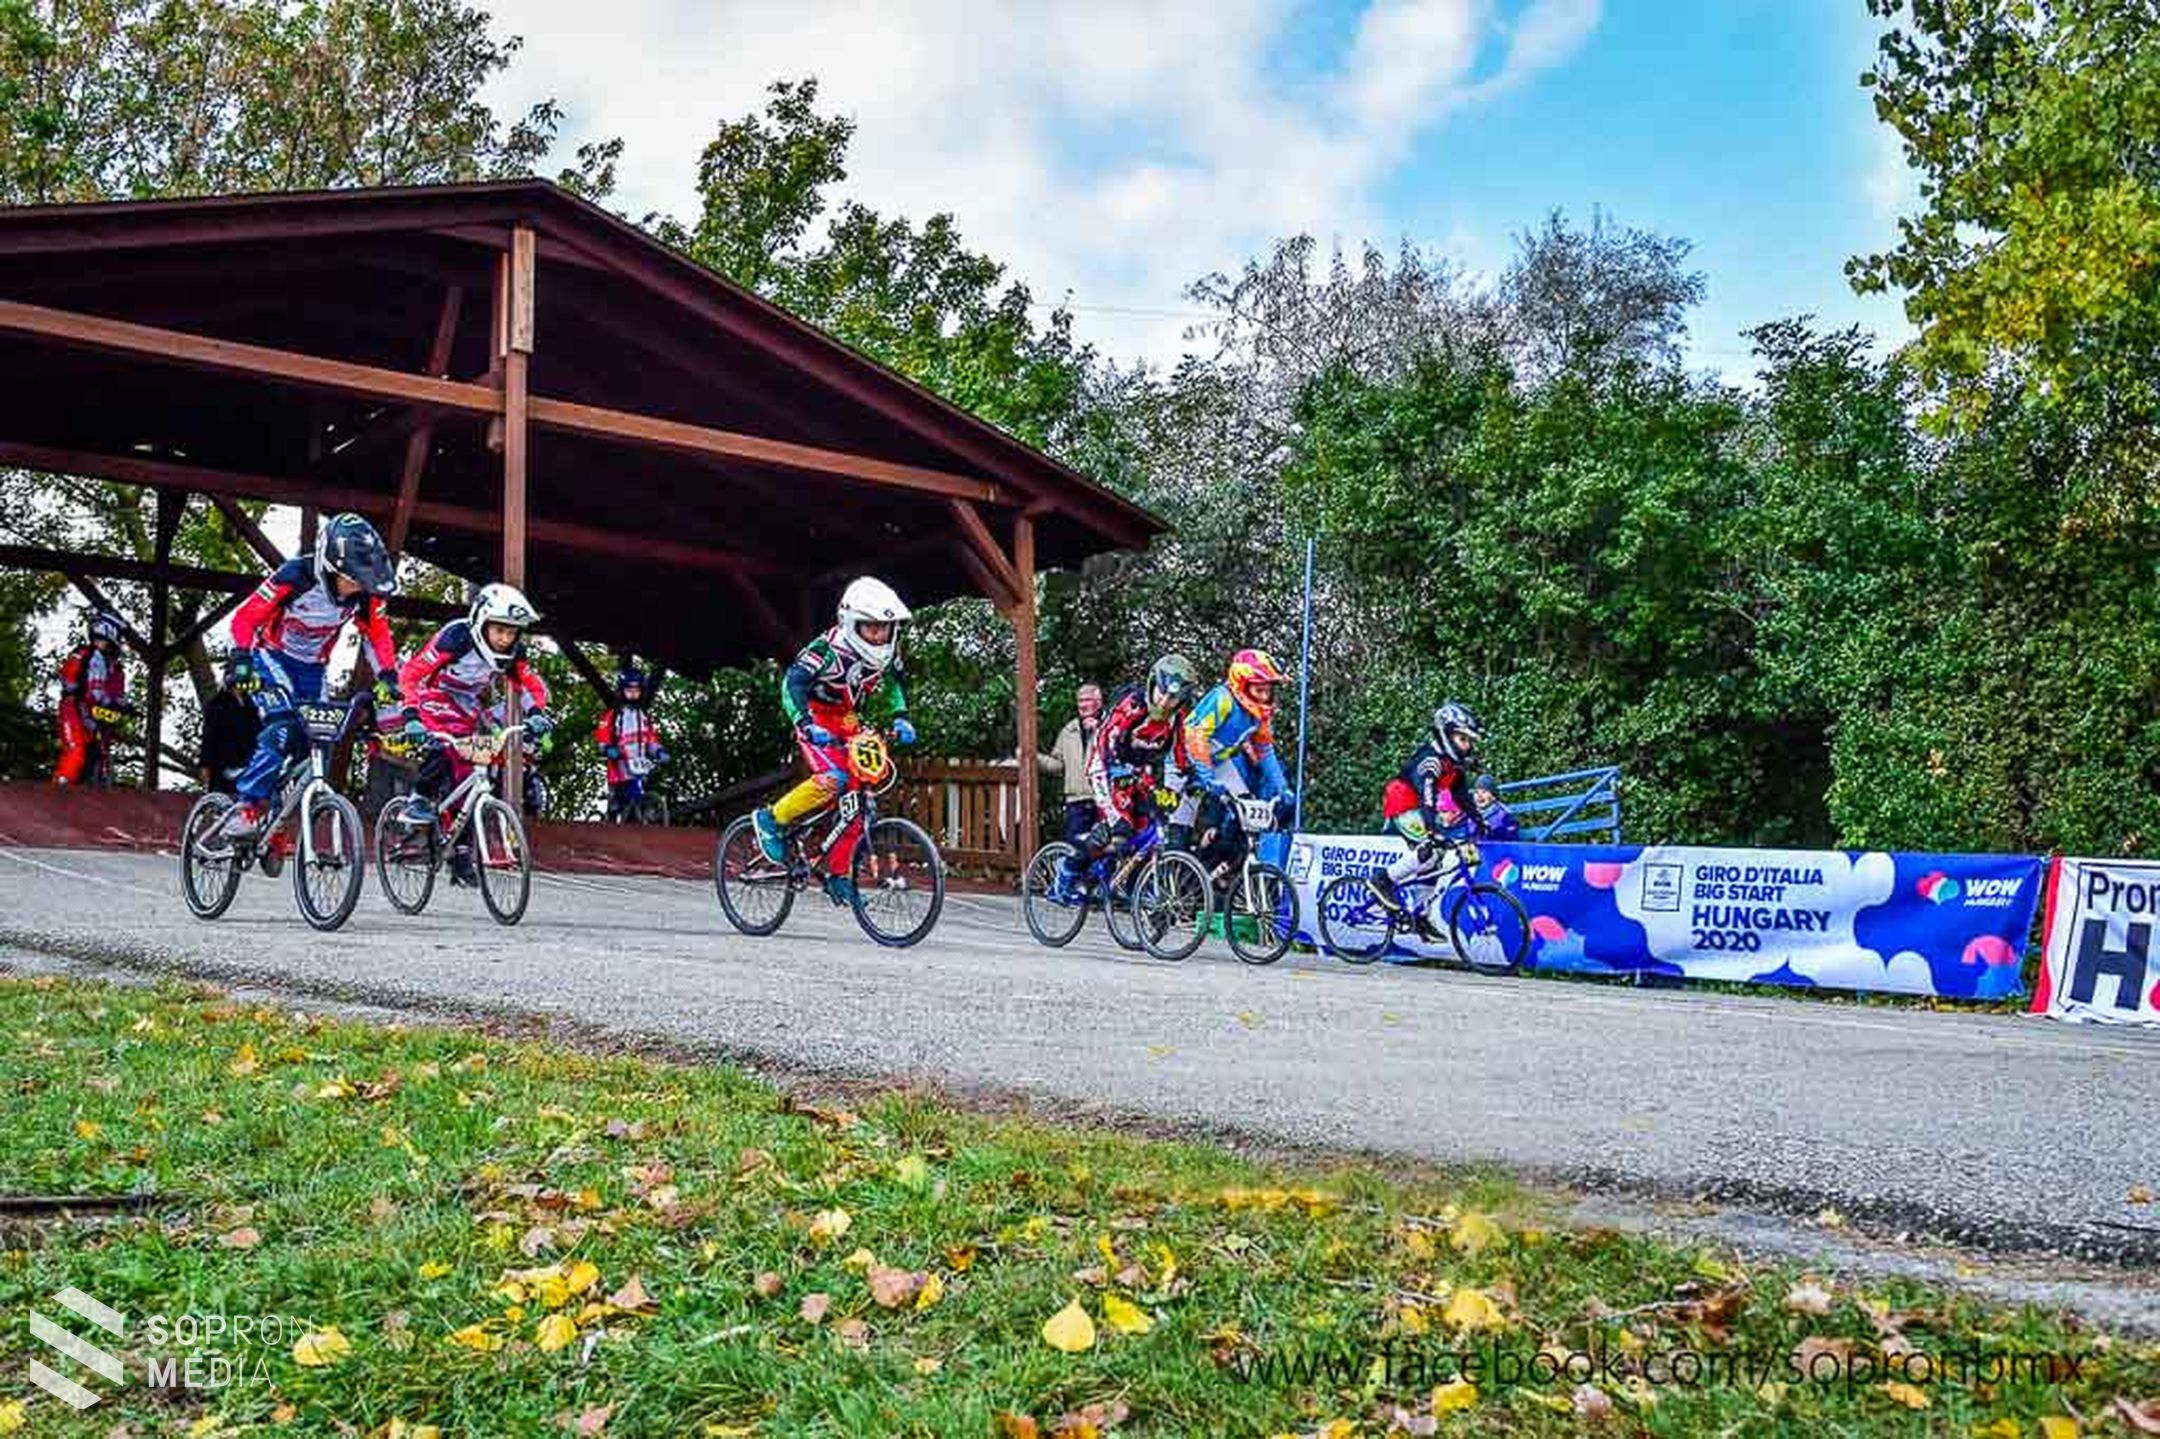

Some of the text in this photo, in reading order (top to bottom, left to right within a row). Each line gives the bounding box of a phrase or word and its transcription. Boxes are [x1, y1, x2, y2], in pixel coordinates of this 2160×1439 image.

[857, 741, 882, 769] 51
[841, 793, 857, 815] 51
[1322, 846, 1403, 865] GIRO D'ITA
[1322, 862, 1342, 877] BIG
[1344, 864, 1371, 878] STA
[1522, 865, 1567, 881] WOW
[1696, 865, 1823, 885] GIRO D'ITALIA
[1693, 883, 1725, 900] BIG
[1728, 884, 1786, 902] START
[1965, 878, 2023, 897] WOW
[1692, 905, 1831, 932] HUNGARY
[1692, 929, 1761, 952] 2020
